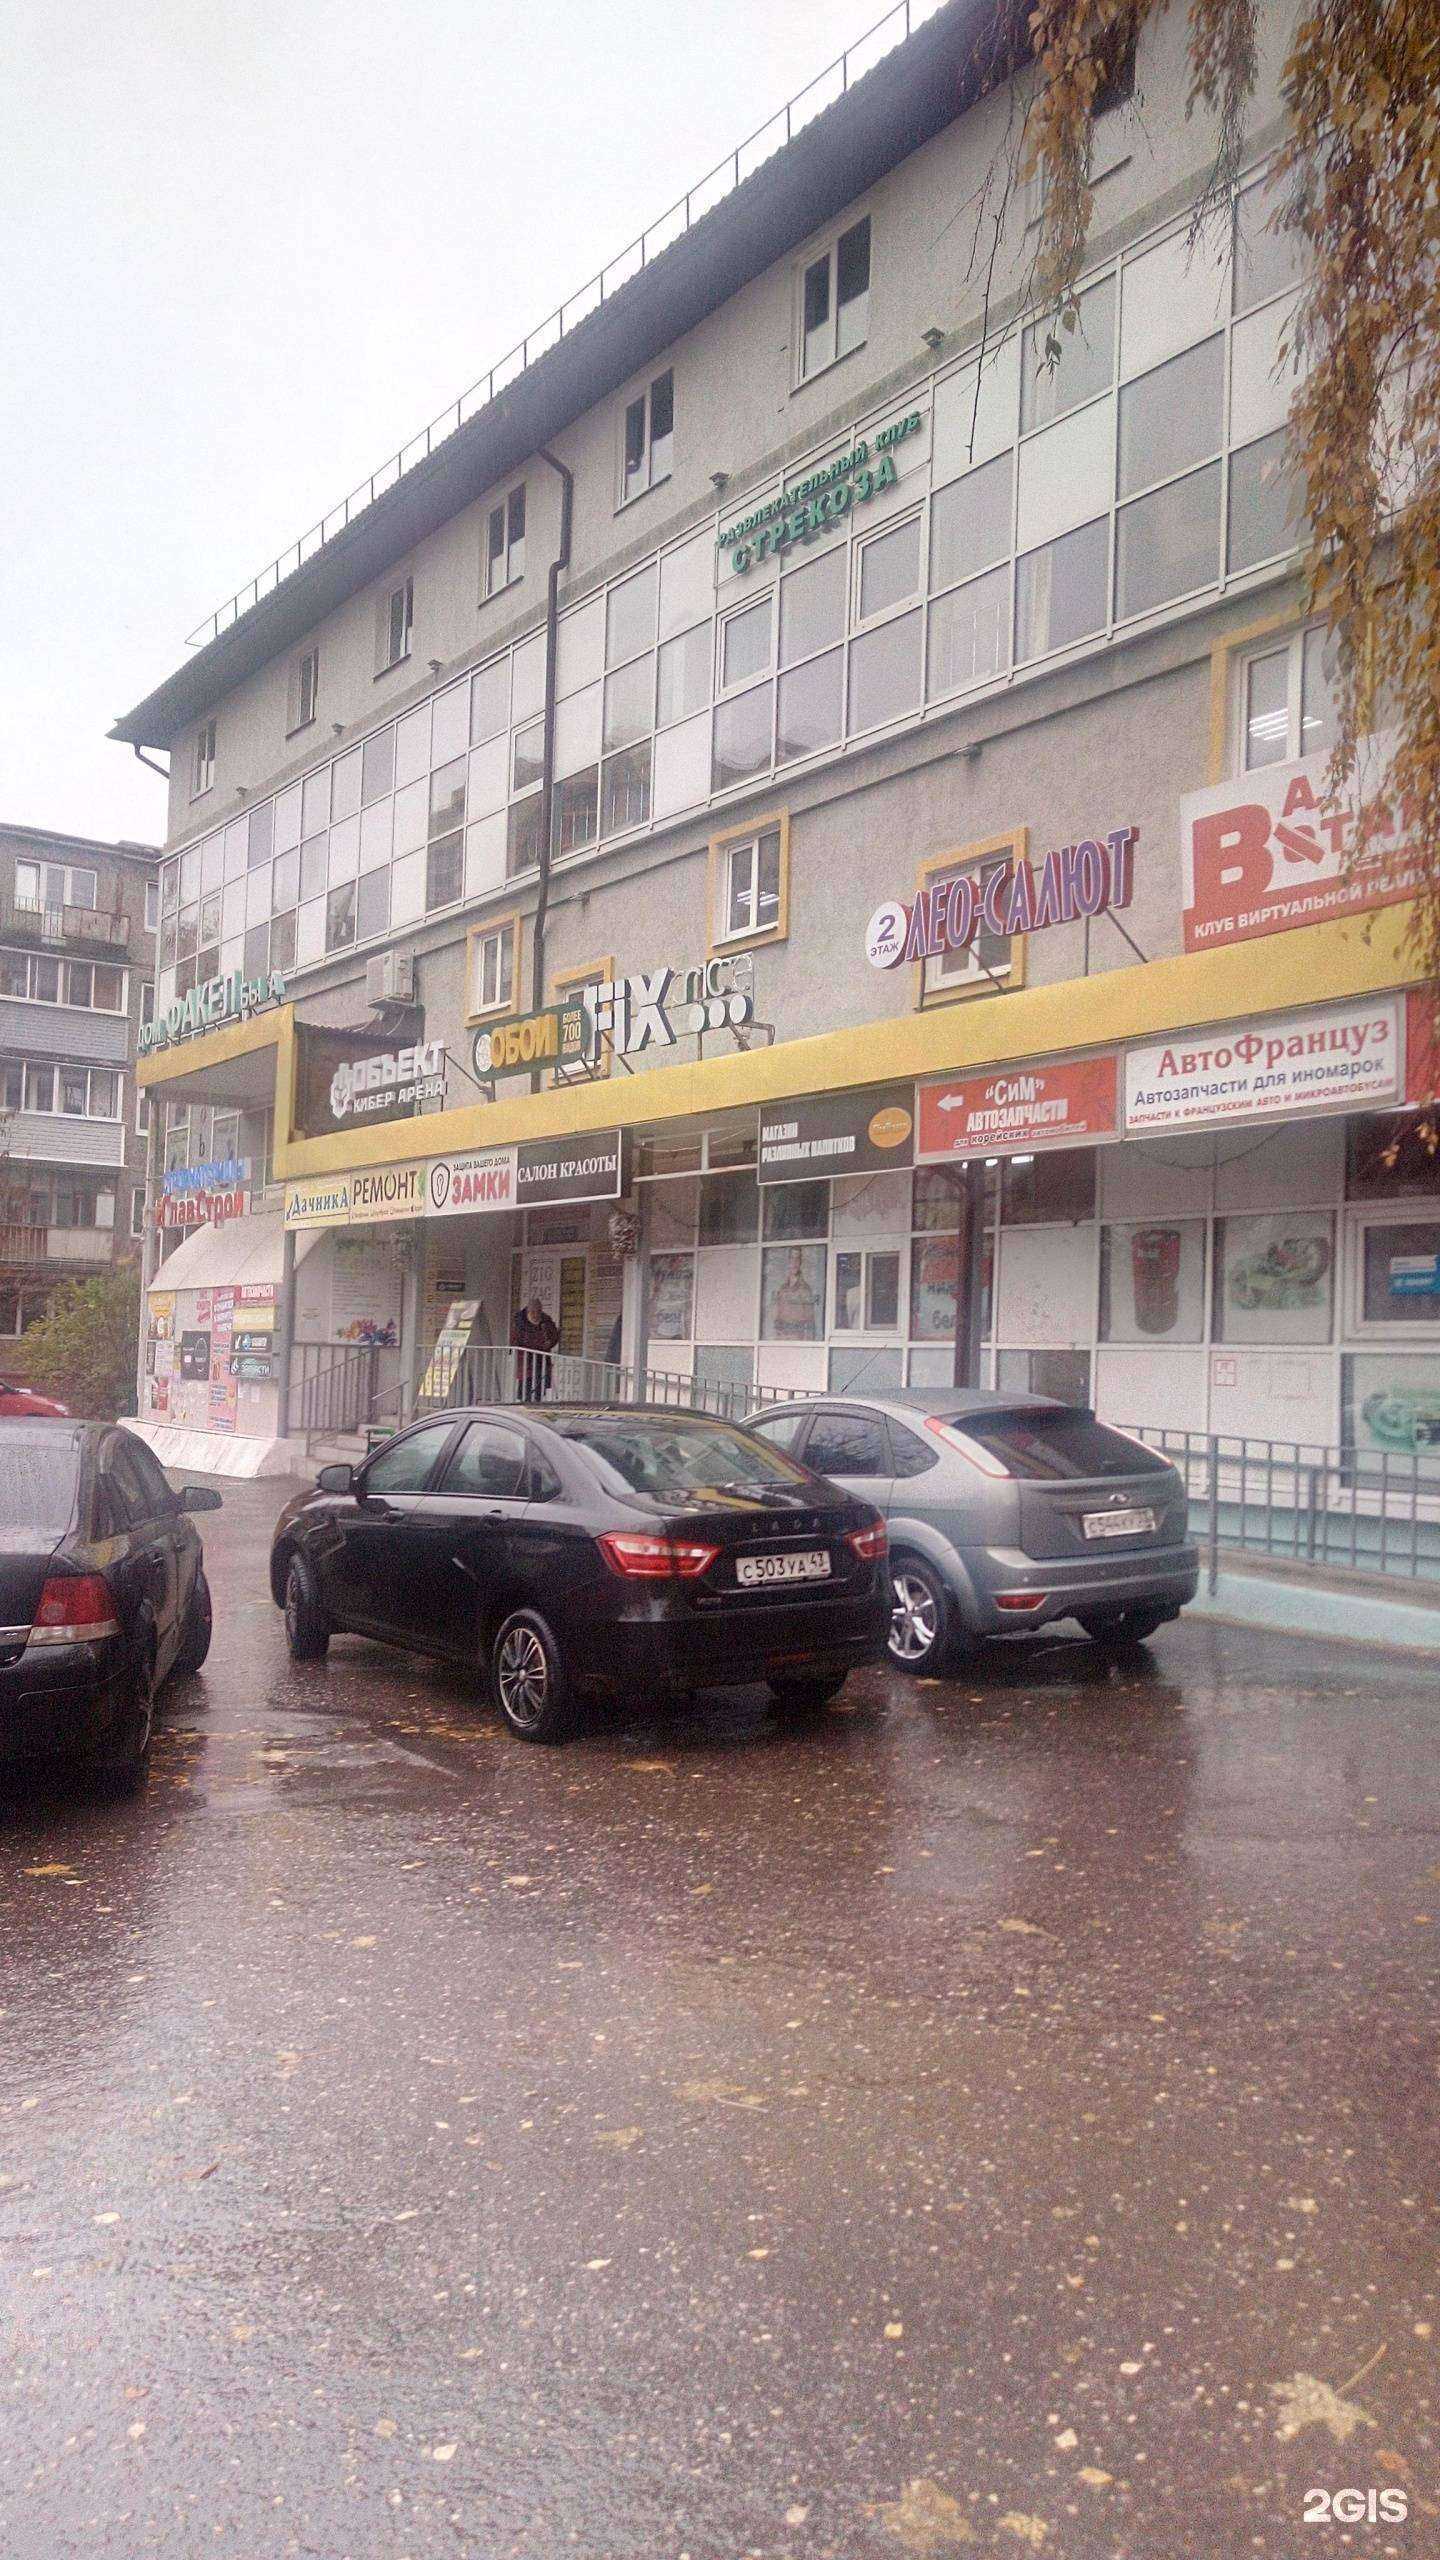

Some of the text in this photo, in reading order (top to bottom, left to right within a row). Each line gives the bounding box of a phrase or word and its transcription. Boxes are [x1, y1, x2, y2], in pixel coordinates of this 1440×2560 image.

[732, 455, 897, 573] СТРЕКОЗА
[906, 826, 1139, 961] ЛЕО-САЛЮТ
[1194, 915, 1235, 939] КЛУБ
[1238, 883, 1362, 929] ВИРТУАЛЬНОЙ
[878, 914, 895, 942] 2
[870, 941, 899, 957] ЭТАЖ
[167, 970, 242, 1037] ФАКЕЛ
[584, 967, 676, 1061] FIX
[491, 1014, 558, 1069] ОБОИ
[563, 1021, 581, 1042] 700
[1157, 1020, 1390, 1078] АвтоФранцуз
[353, 1080, 446, 1114] КИБЕР АРЕНА
[1134, 1057, 1385, 1106] Автозапчасти для иномарок
[967, 1098, 1069, 1132] АВТОЗАПЧАСТИ
[1128, 1109, 1172, 1125] ЗАПЧАСТИ
[1174, 1109, 1182, 1119] К
[1257, 1093, 1281, 1107] АВТО
[1283, 1092, 1293, 1103] И
[762, 1122, 798, 1142] МАГАЗИН
[811, 1135, 856, 1157] НАПИТКОВ
[517, 1154, 617, 1183] САЛОН КРАСОТЫ
[353, 1170, 418, 1206] РЕМОНТ
[452, 1169, 511, 1206] ЗАМКИ
